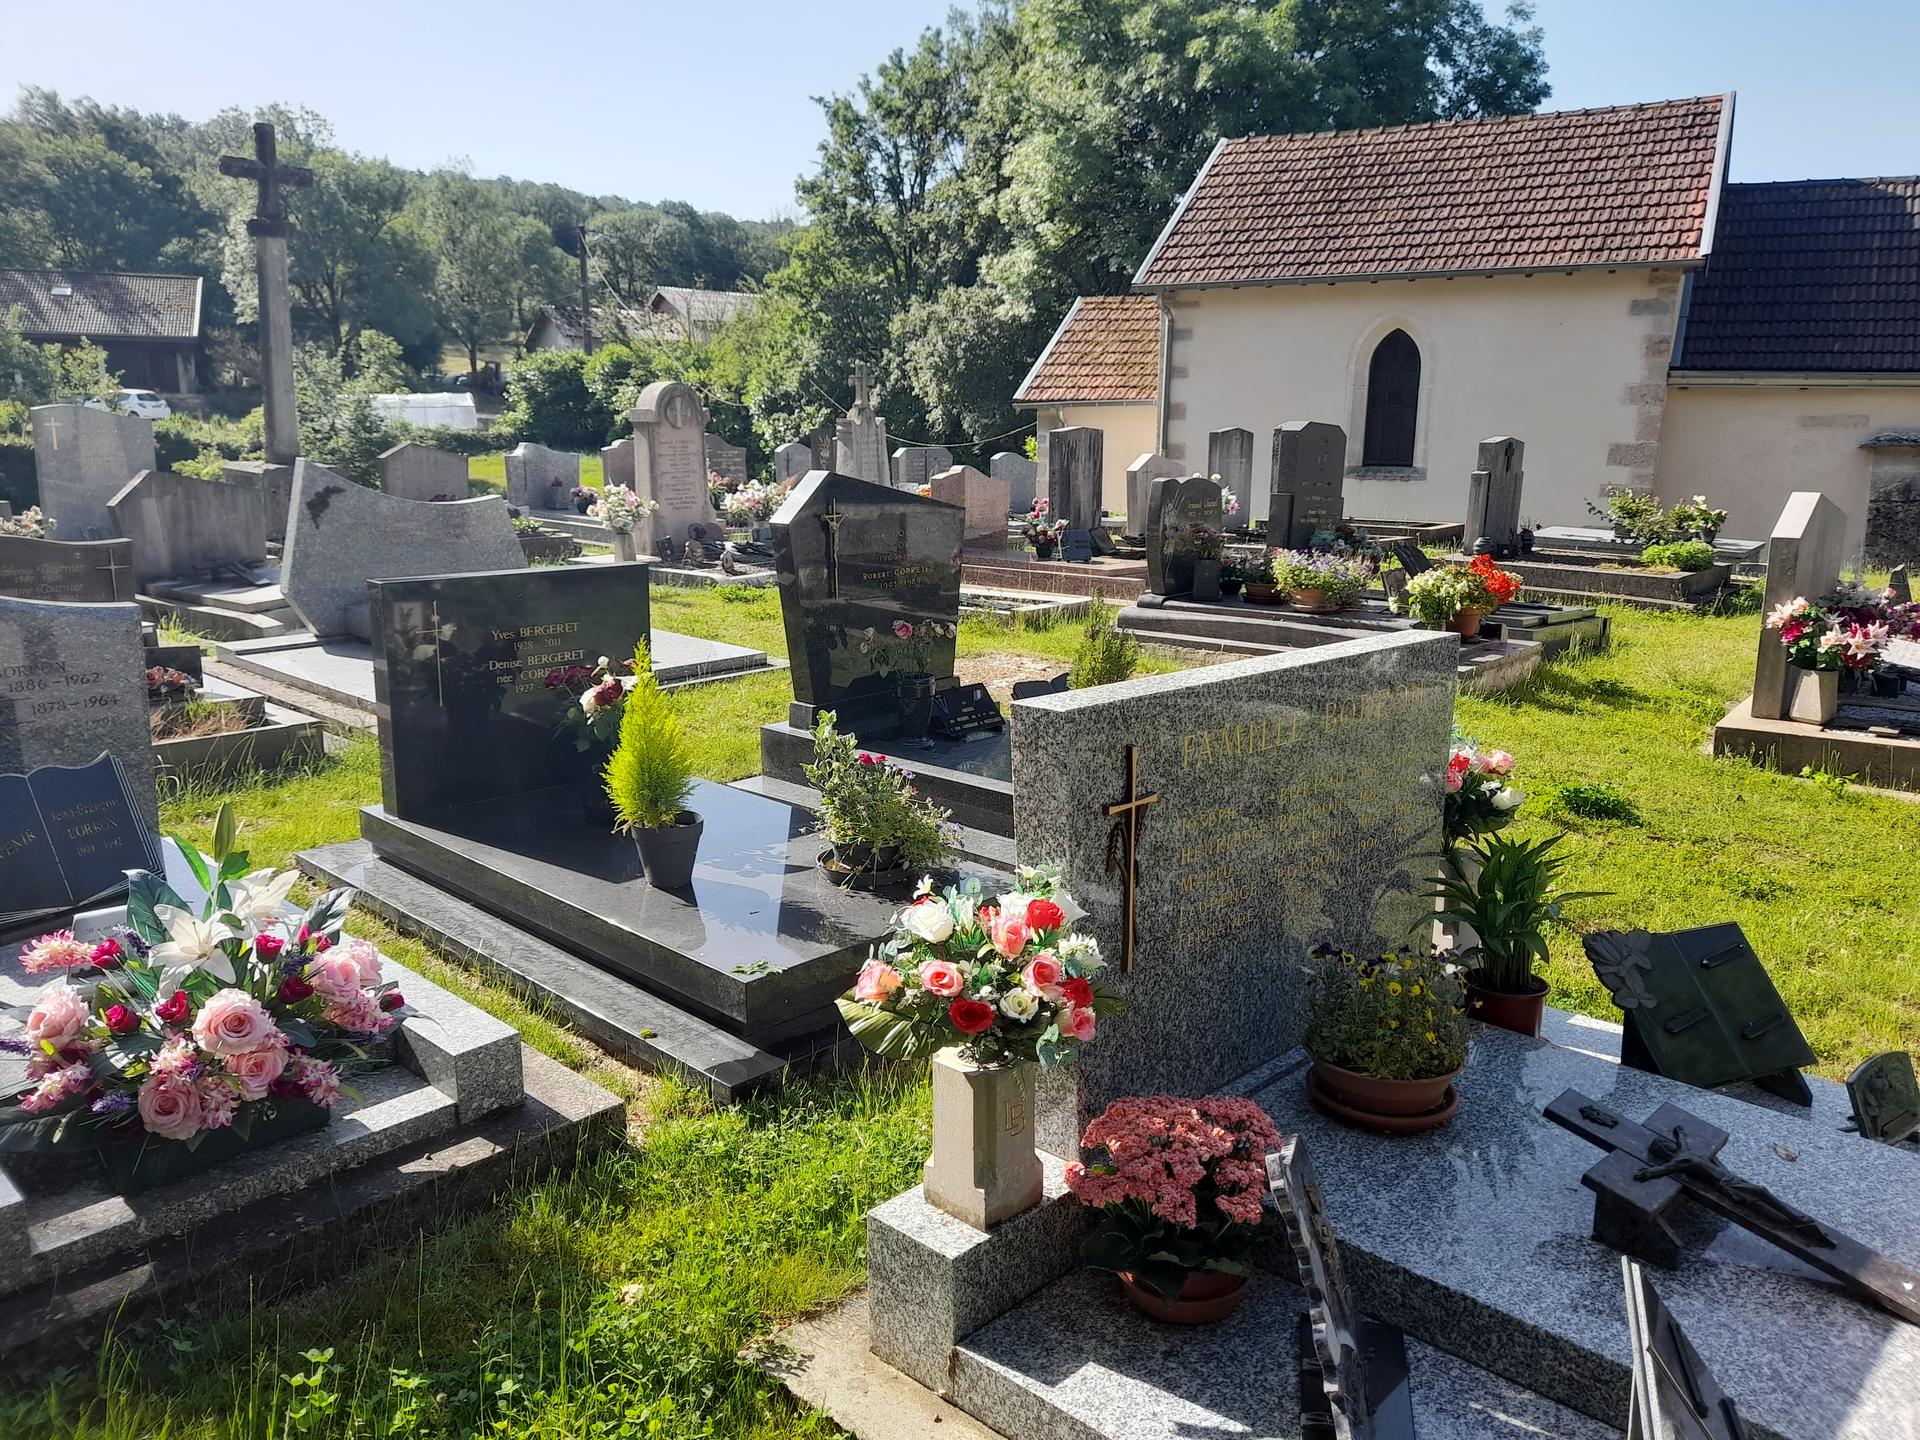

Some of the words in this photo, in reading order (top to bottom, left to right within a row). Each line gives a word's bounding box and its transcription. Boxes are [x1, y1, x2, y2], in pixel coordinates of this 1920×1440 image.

[491, 630, 516, 641] Yves
[519, 622, 580, 638] BERGERET
[513, 640, 534, 651] 1928
[489, 658, 523, 671] Denise
[527, 650, 586, 666] BERGERET
[515, 682, 535, 694] 1927
[1182, 710, 1303, 773] FAMILLE
